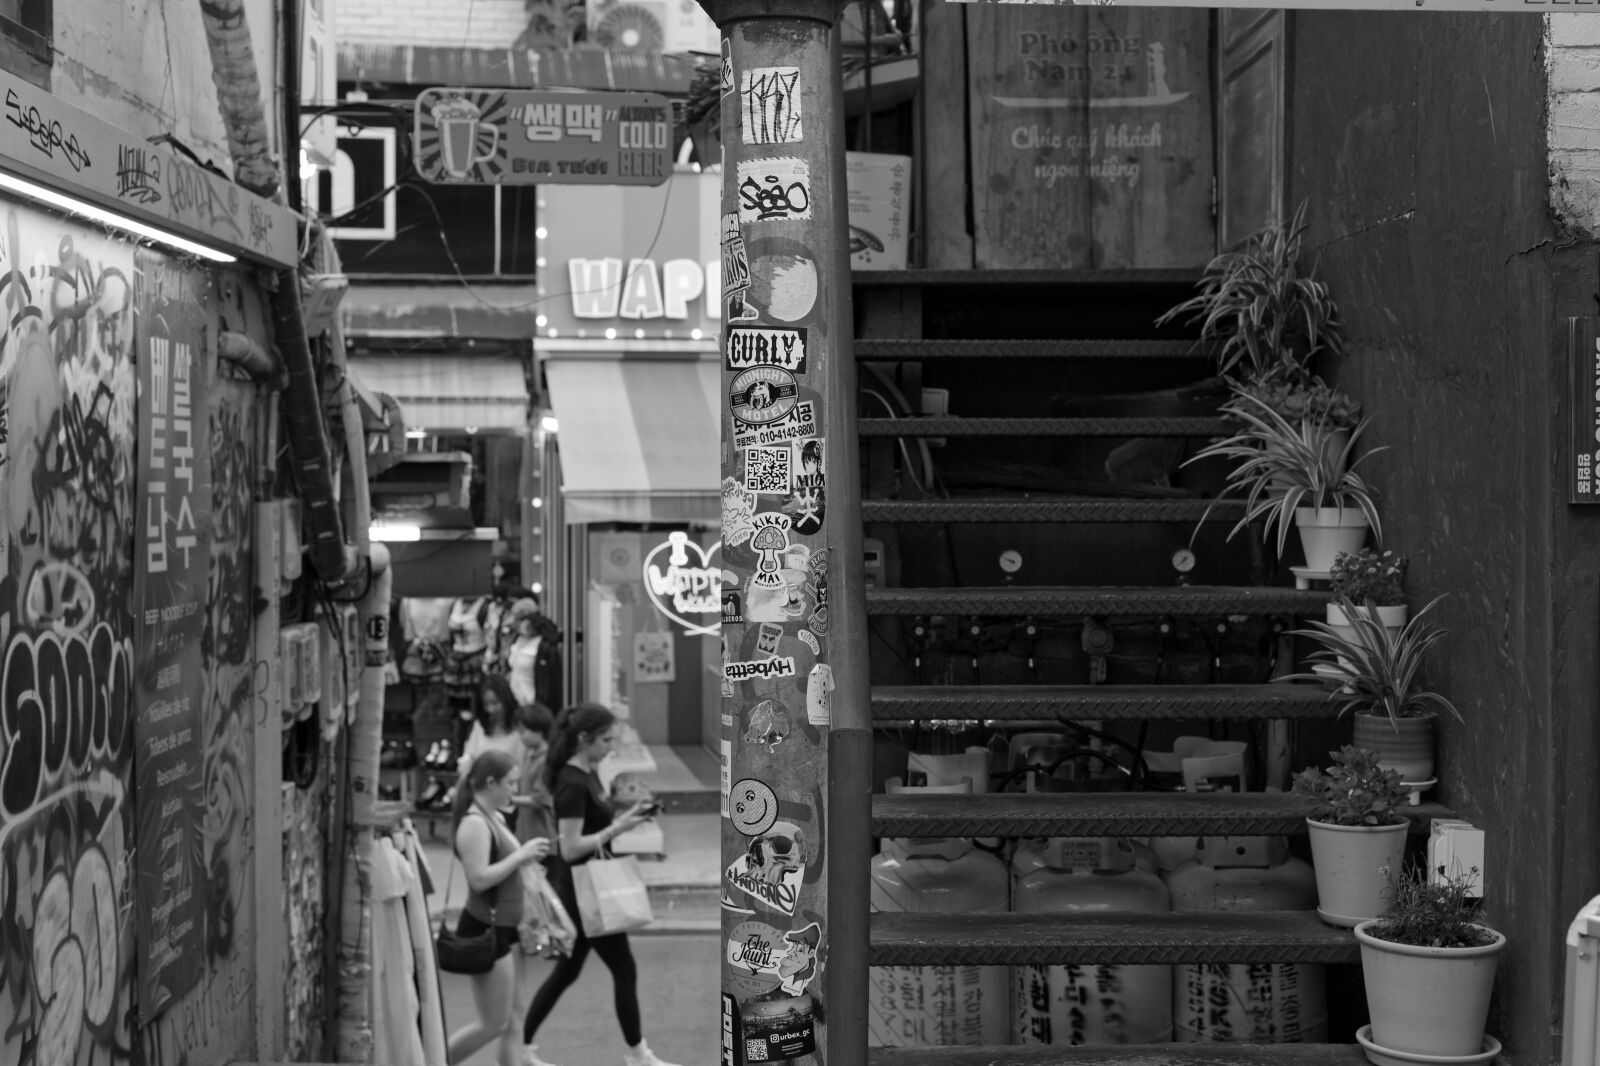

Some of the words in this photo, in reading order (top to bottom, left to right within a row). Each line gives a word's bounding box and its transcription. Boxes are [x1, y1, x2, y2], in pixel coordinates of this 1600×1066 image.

[619, 106, 666, 122] ALWAYS
[619, 121, 667, 149] COLD
[1105, 122, 1162, 148] khách
[619, 151, 664, 177] BEER
[1034, 163, 1079, 188] ngon
[568, 257, 721, 320] WAP
[731, 331, 797, 366] CURLY
[735, 368, 788, 391] MIDNIGHT
[741, 403, 788, 421] MOTEL
[760, 422, 815, 444] 010-4142-8800
[1577, 453, 1590, 494] 영업중
[752, 514, 789, 531] KIKKO
[756, 571, 780, 584] MAI
[145, 608, 159, 625] BEEF
[725, 656, 792, 678] Hybetta
[747, 933, 770, 952] The
[732, 942, 773, 967] Jaunt
